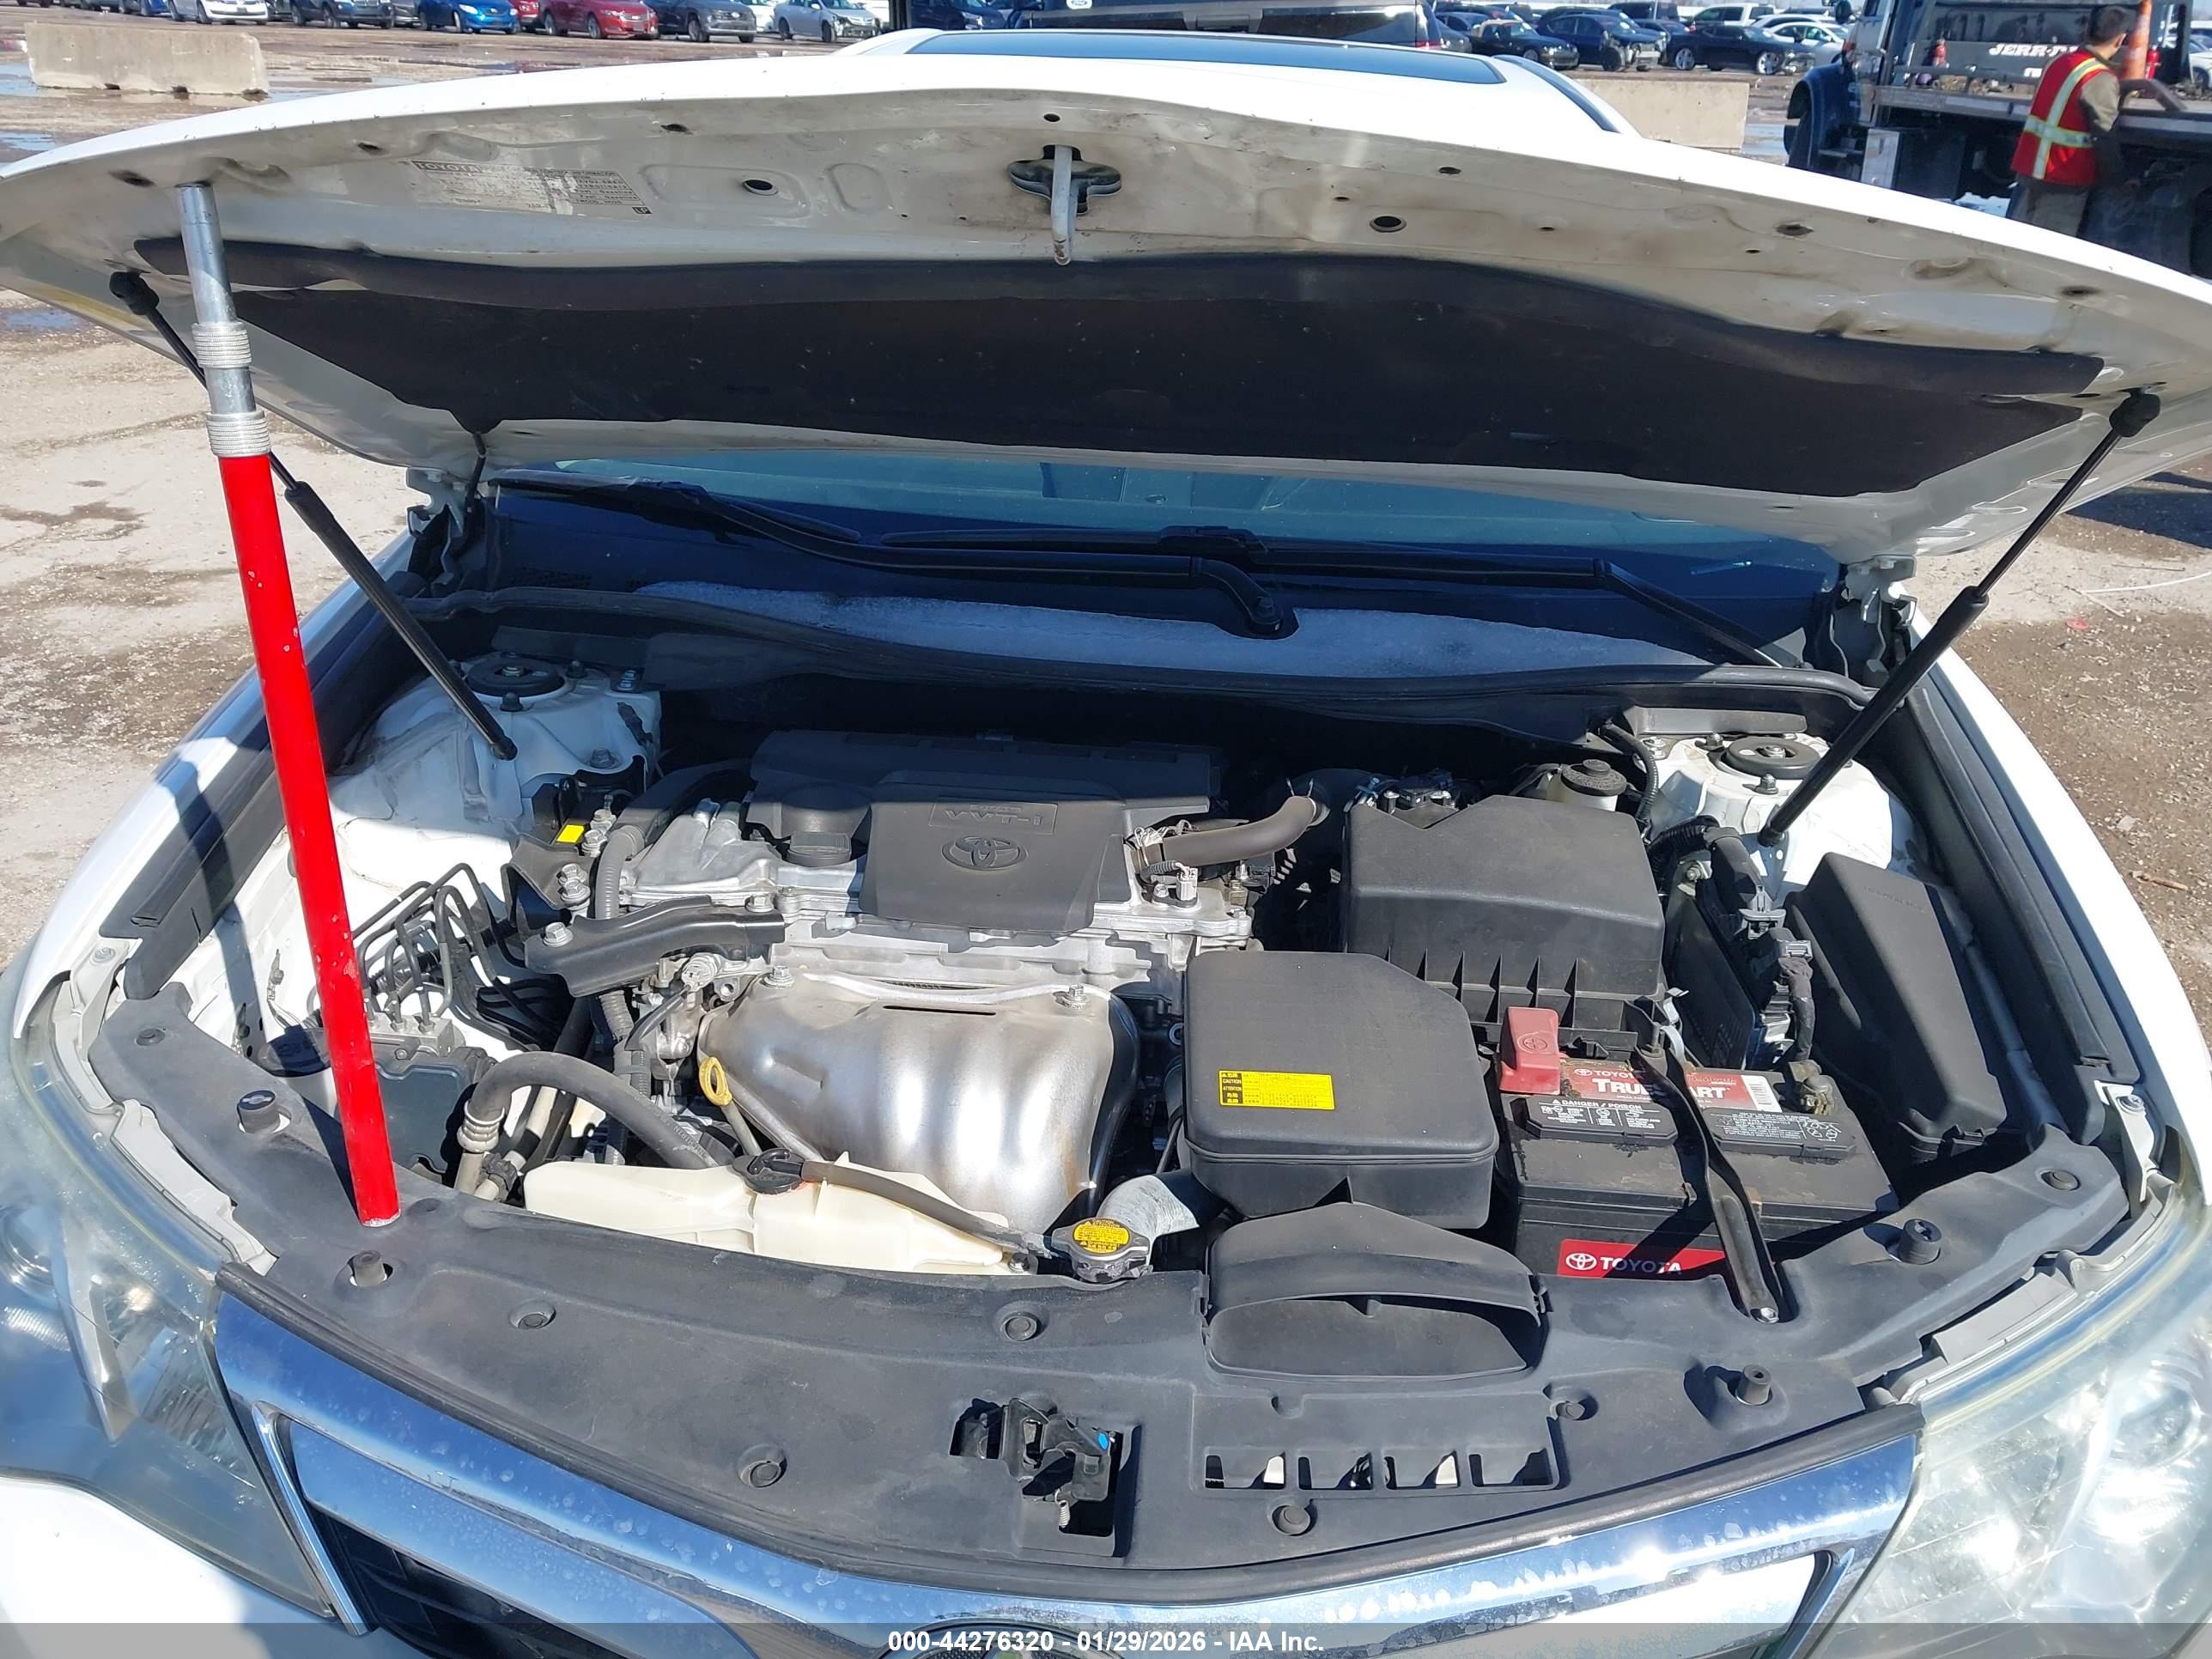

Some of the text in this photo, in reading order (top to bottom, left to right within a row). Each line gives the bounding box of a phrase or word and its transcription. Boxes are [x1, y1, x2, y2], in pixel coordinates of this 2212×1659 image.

[416, 162, 481, 173] TOYOTA
[1593, 1070, 1636, 1079] TOYOT
[1561, 1099, 1599, 1108] DANGER
[1600, 1256, 1682, 1275] TOYOTA
